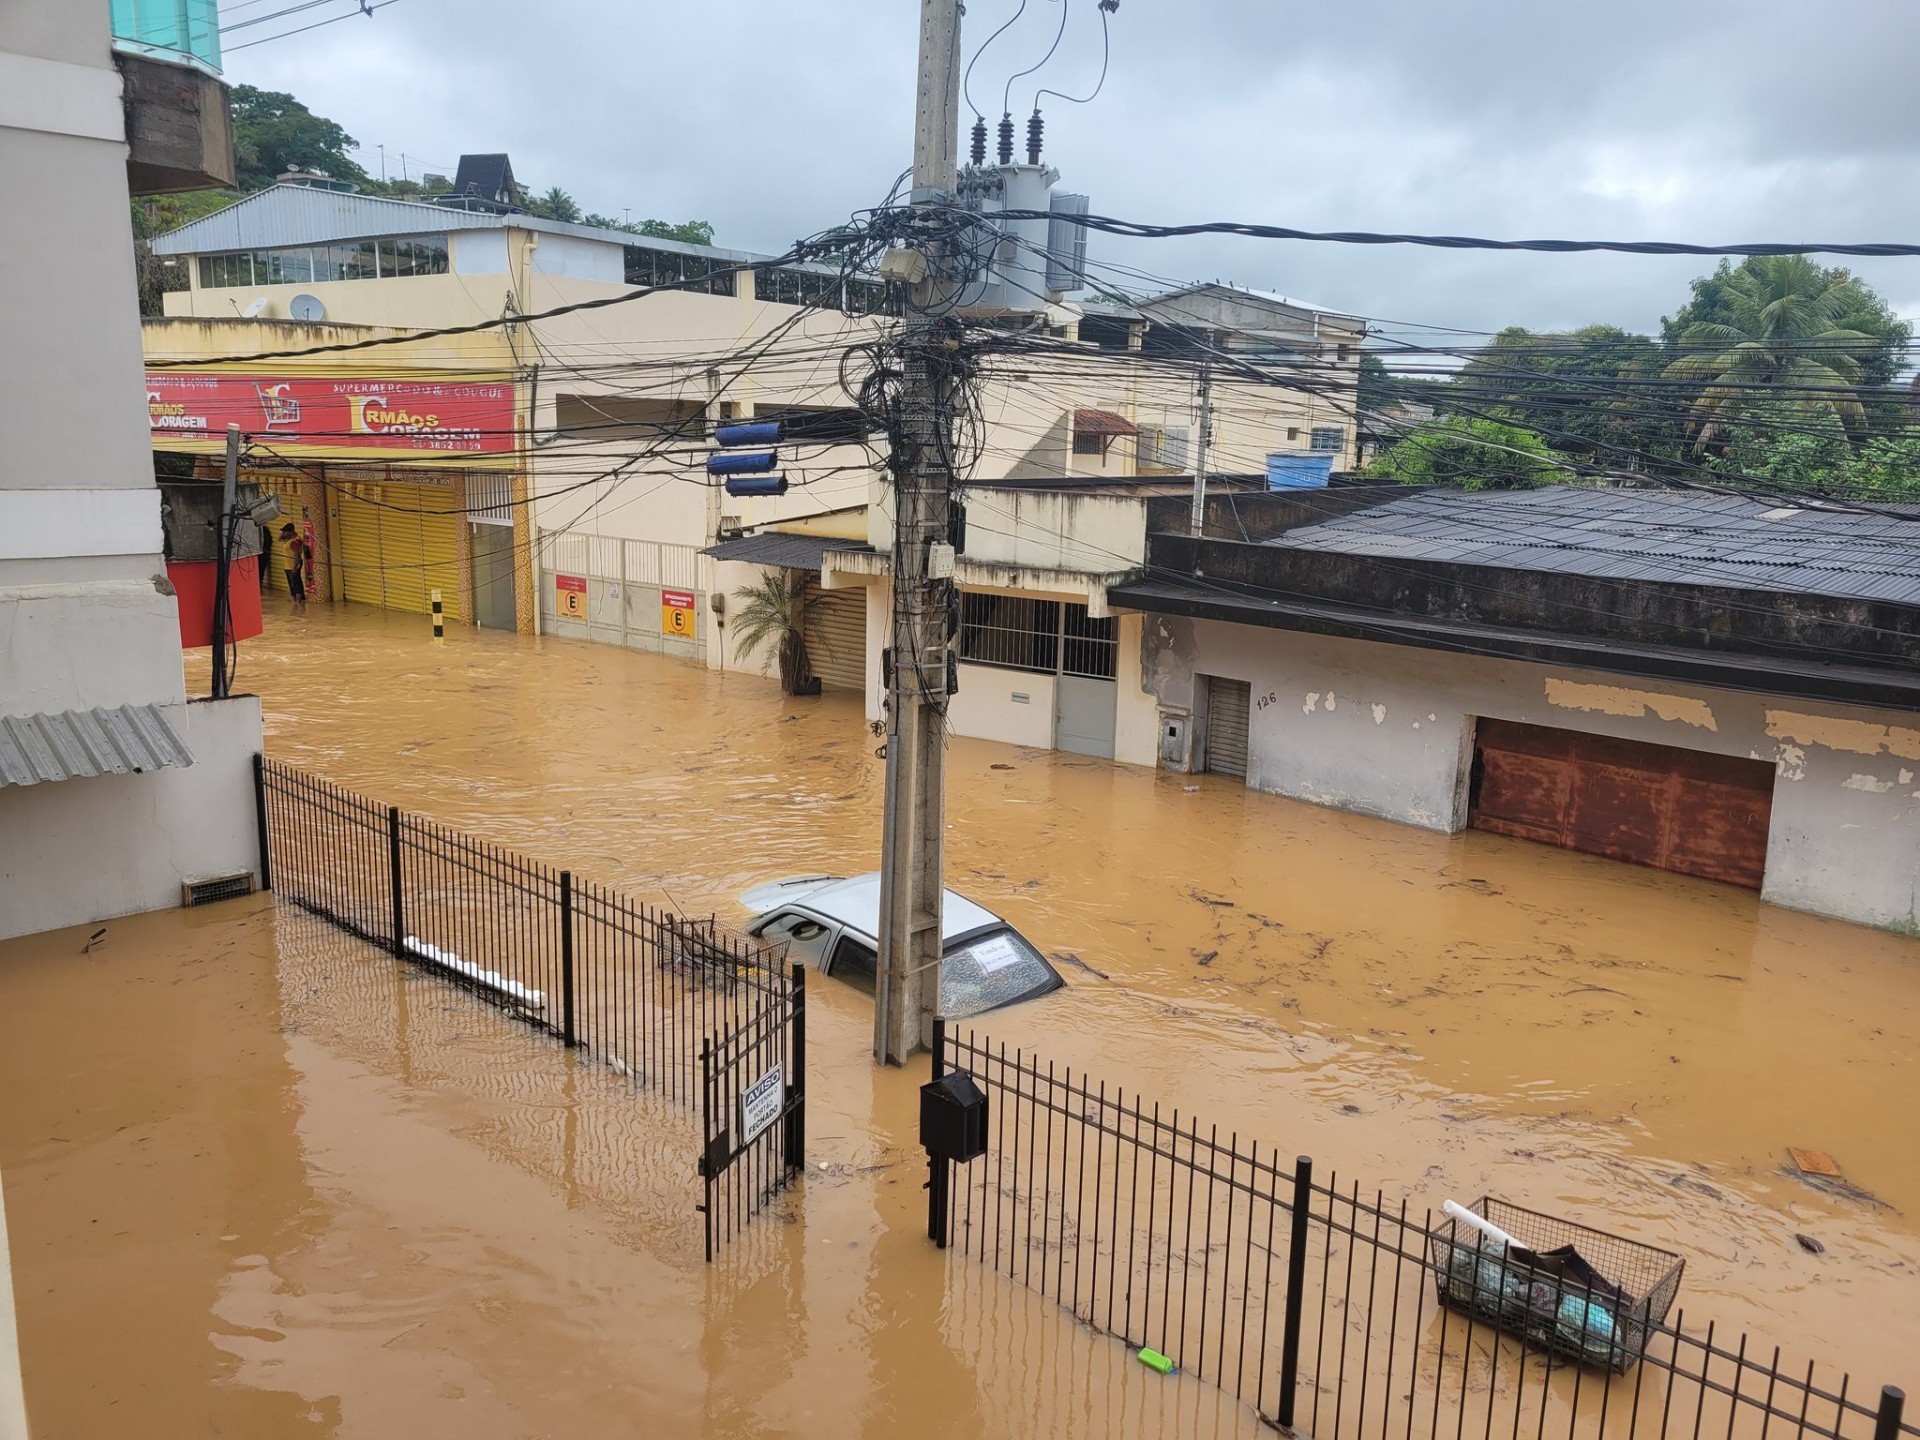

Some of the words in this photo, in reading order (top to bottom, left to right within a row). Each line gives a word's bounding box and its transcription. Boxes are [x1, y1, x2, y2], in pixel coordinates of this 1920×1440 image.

[333, 383, 430, 395] SUPERMERCADO
[149, 402, 185, 416] RMÃOS
[569, 595, 577, 609] E
[675, 612, 682, 626] E
[1256, 692, 1277, 711] 126
[747, 1071, 780, 1105] AVISO
[748, 1090, 774, 1115] MANTENHA
[754, 1099, 774, 1119] PORTÃO
[748, 1104, 778, 1135] FECHADO
